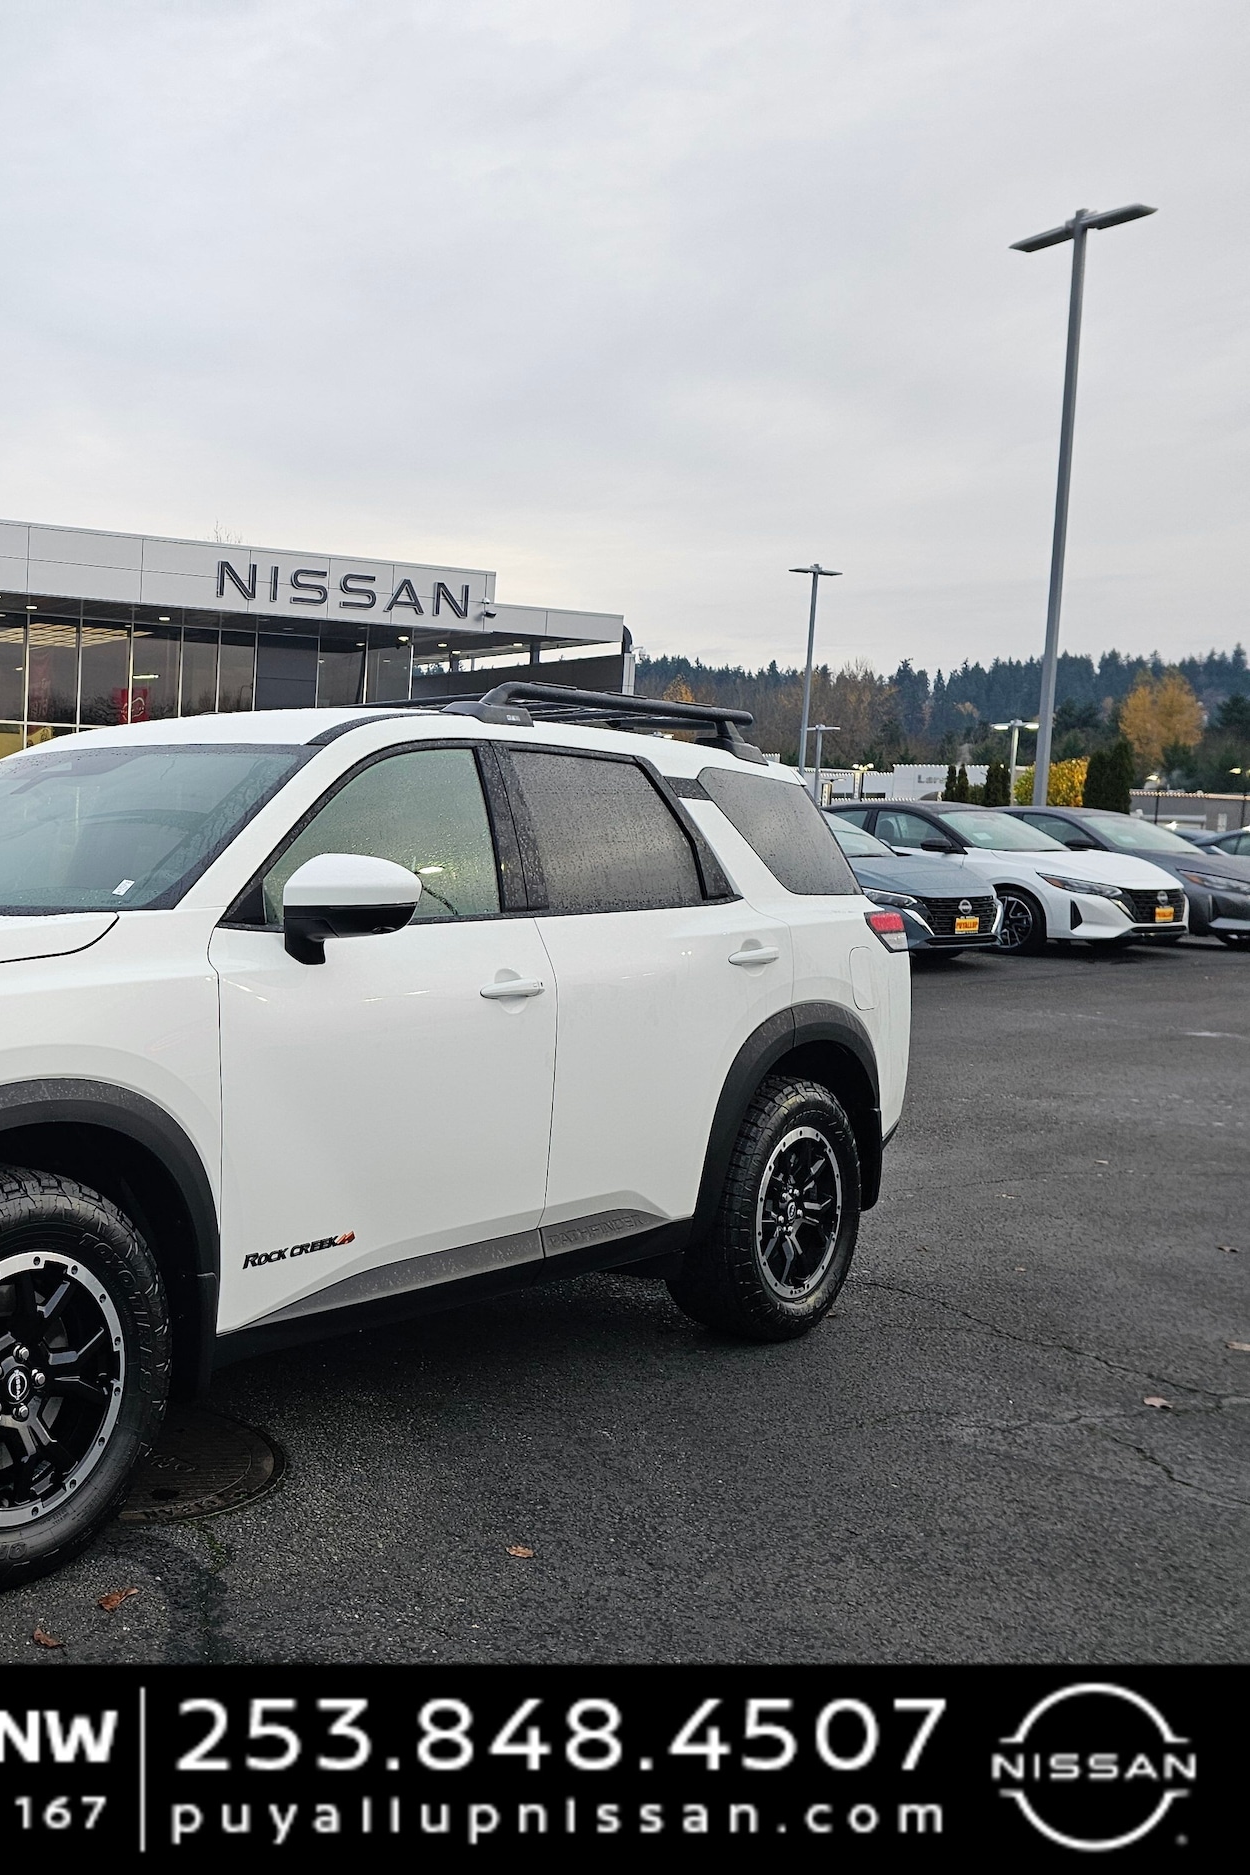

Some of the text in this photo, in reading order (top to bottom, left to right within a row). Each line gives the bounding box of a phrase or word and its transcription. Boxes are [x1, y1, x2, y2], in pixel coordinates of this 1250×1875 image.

[217, 560, 469, 618] NISSAN
[242, 1235, 339, 1270] ROCK CREEK
